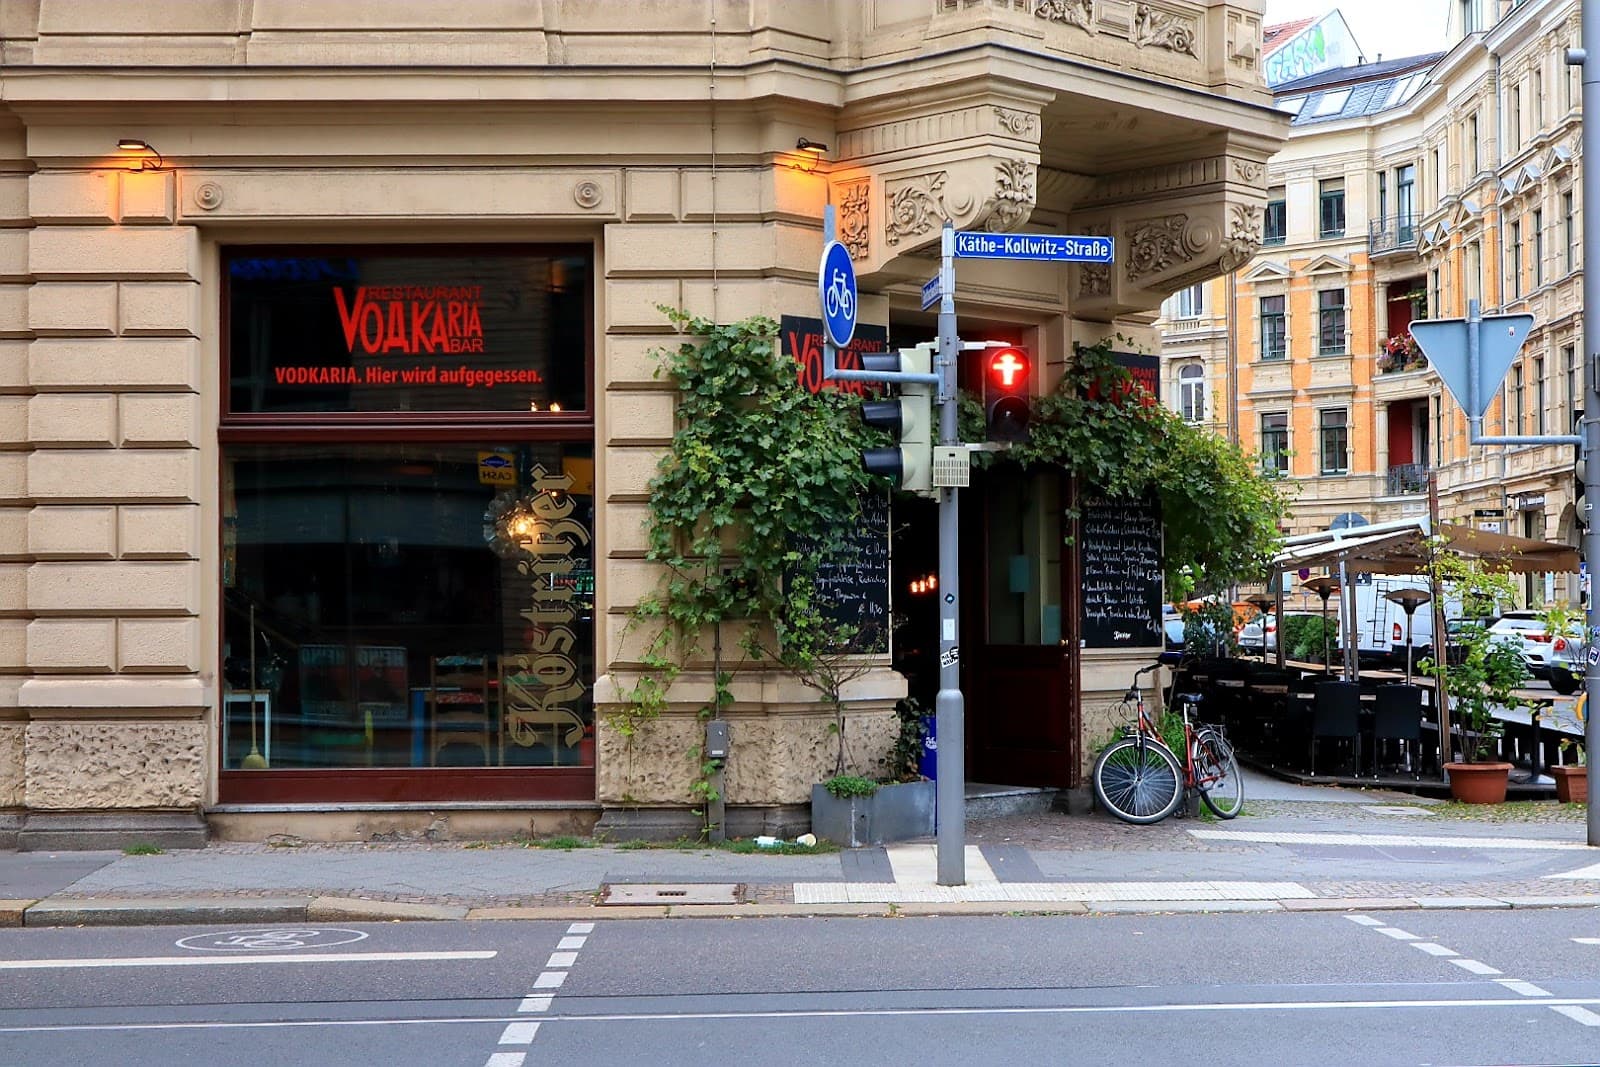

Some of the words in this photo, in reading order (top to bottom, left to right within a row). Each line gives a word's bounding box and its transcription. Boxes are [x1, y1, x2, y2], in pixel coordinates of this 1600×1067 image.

[959, 236, 1108, 257] Käthe-Kollwitz-Straße
[367, 286, 483, 300] RESTAURANT
[449, 338, 484, 354] BAR
[811, 334, 883, 351] REURANT
[275, 366, 362, 384] VODKARIA.
[365, 366, 399, 384] Hier
[401, 366, 436, 384] wird
[439, 366, 543, 388] aufgegessen.
